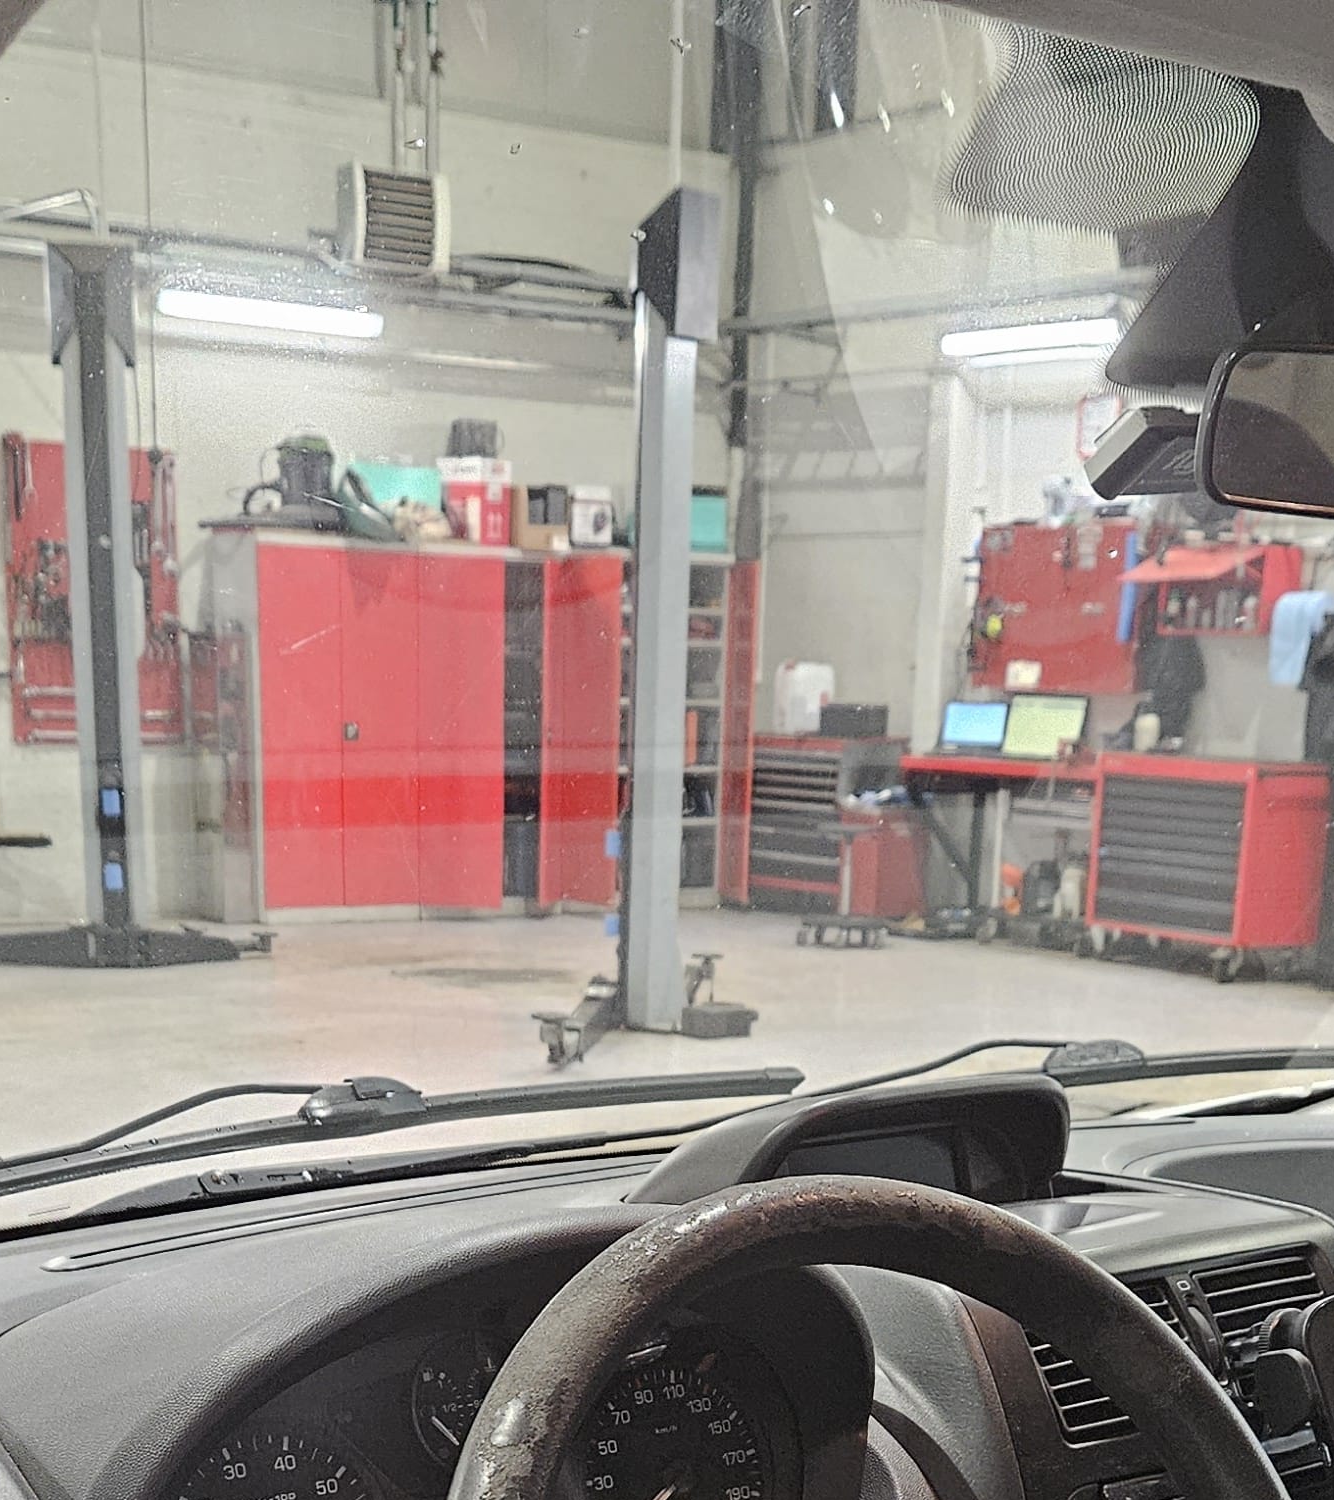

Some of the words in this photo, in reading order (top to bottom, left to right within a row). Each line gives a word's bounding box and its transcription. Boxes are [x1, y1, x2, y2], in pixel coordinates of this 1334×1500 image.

[634, 1390, 654, 1405] 90
[663, 1384, 685, 1400] 110
[686, 1398, 712, 1414] 130
[611, 1410, 631, 1425] 70
[708, 1419, 732, 1435] 150
[598, 1440, 618, 1455] 50
[273, 1454, 297, 1471] 40
[722, 1450, 746, 1466] 170
[223, 1463, 247, 1480] 30
[315, 1478, 339, 1496] 50
[594, 1475, 614, 1490] 30
